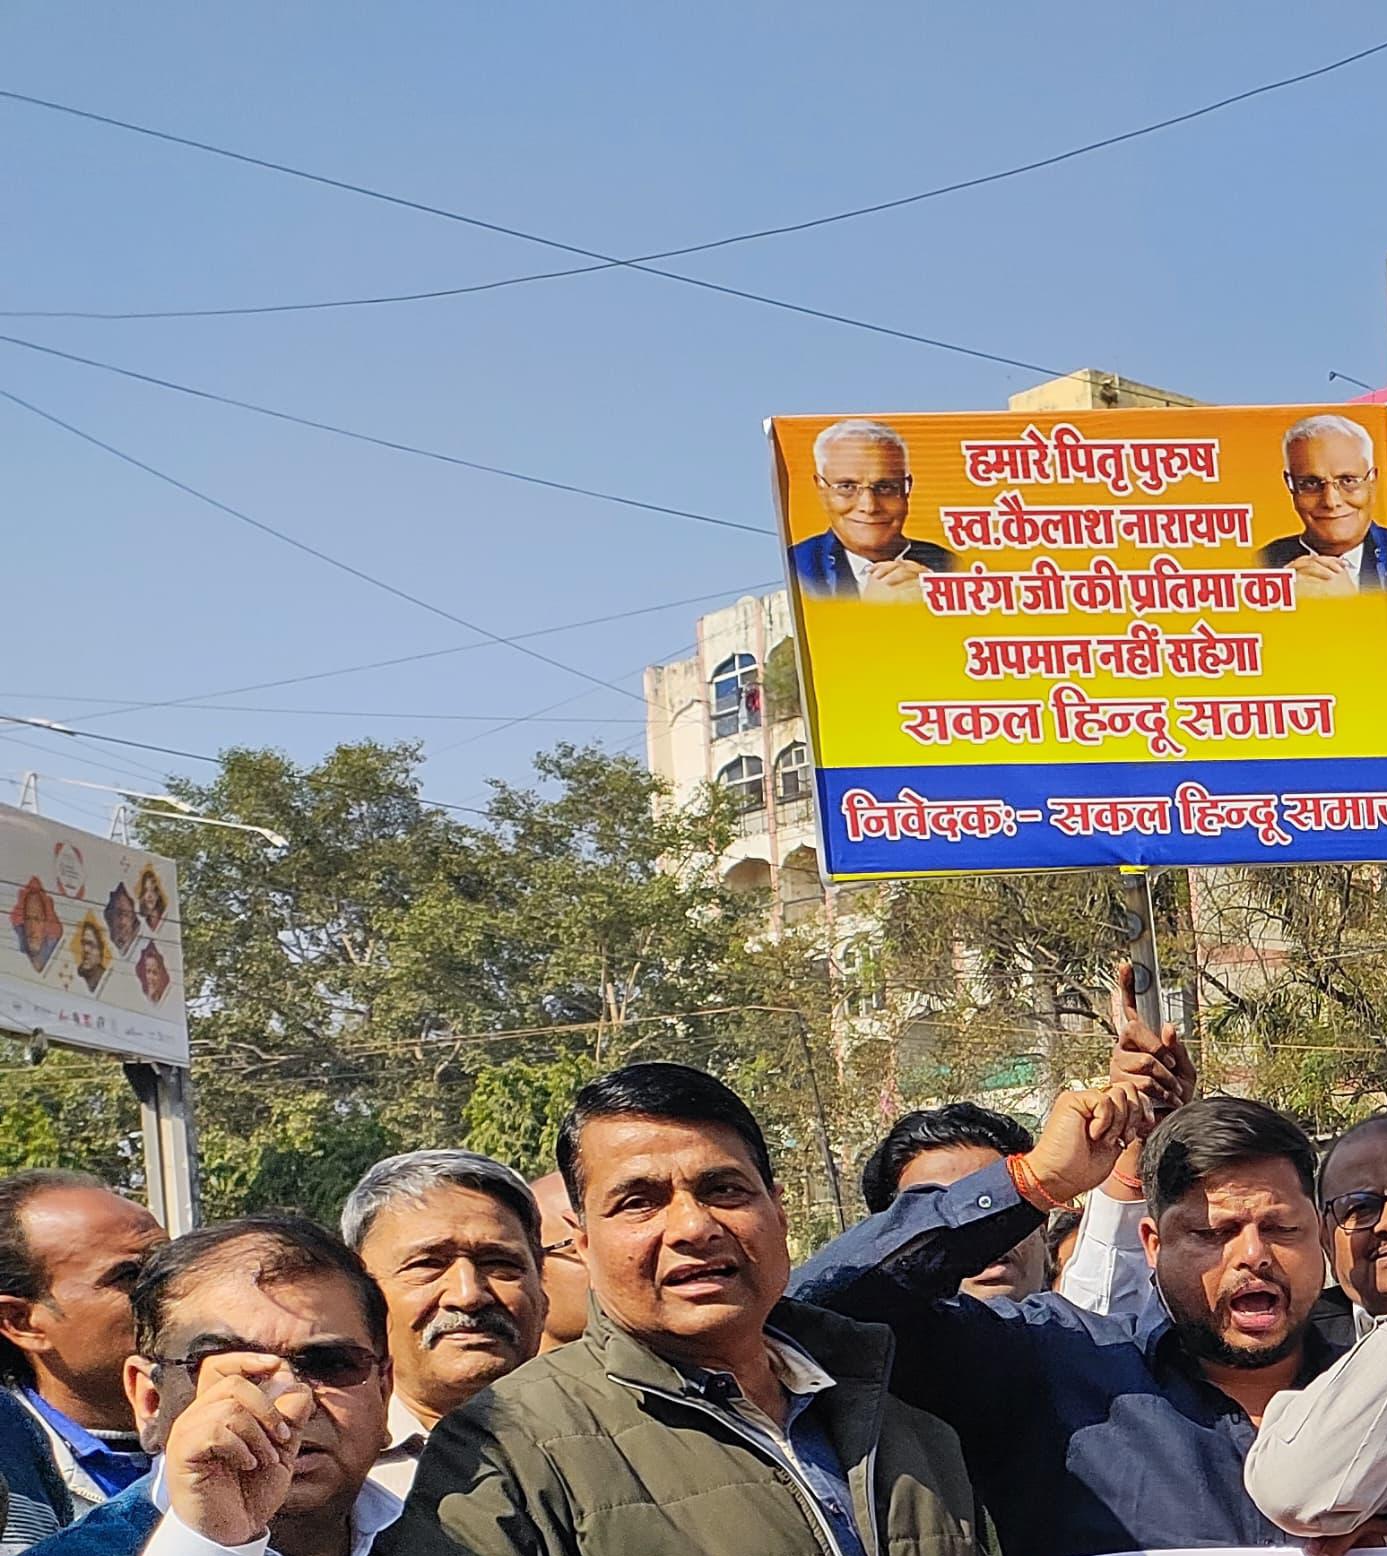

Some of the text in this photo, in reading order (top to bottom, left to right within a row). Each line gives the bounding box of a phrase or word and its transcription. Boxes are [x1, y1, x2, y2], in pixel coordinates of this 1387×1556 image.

[968, 428, 1216, 491] हमारे पितृ पुरुष
[1124, 508, 1249, 545] नारायण
[924, 557, 1293, 613] सारंग जी की प्रतिमा का
[968, 627, 1259, 676] अपमान नहीं सहेगा
[903, 688, 1332, 753] सकल हिन्दू समाज
[1049, 800, 1170, 833] सकल
[1178, 784, 1290, 842] हिन्दू
